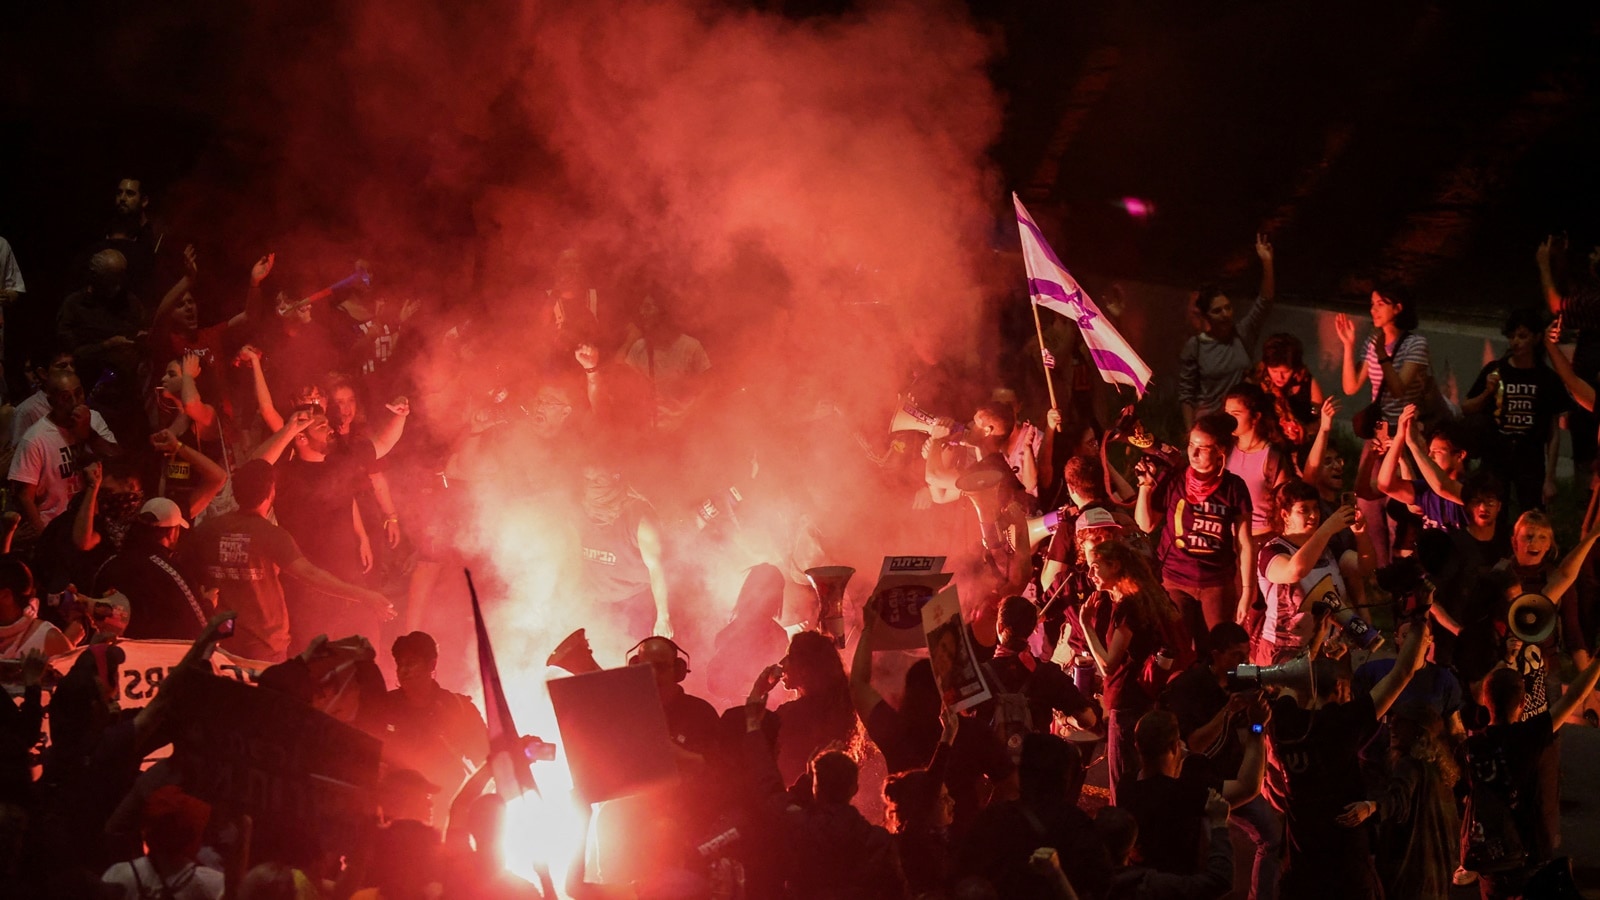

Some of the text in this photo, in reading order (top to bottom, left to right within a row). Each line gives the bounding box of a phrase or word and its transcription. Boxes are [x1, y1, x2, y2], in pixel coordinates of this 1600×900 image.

[1506, 384, 1537, 395] דרום
[1508, 400, 1532, 411] חזק
[1505, 415, 1534, 425] ביחד
[1192, 518, 1223, 533] חזק
[891, 557, 934, 568] הביתה
